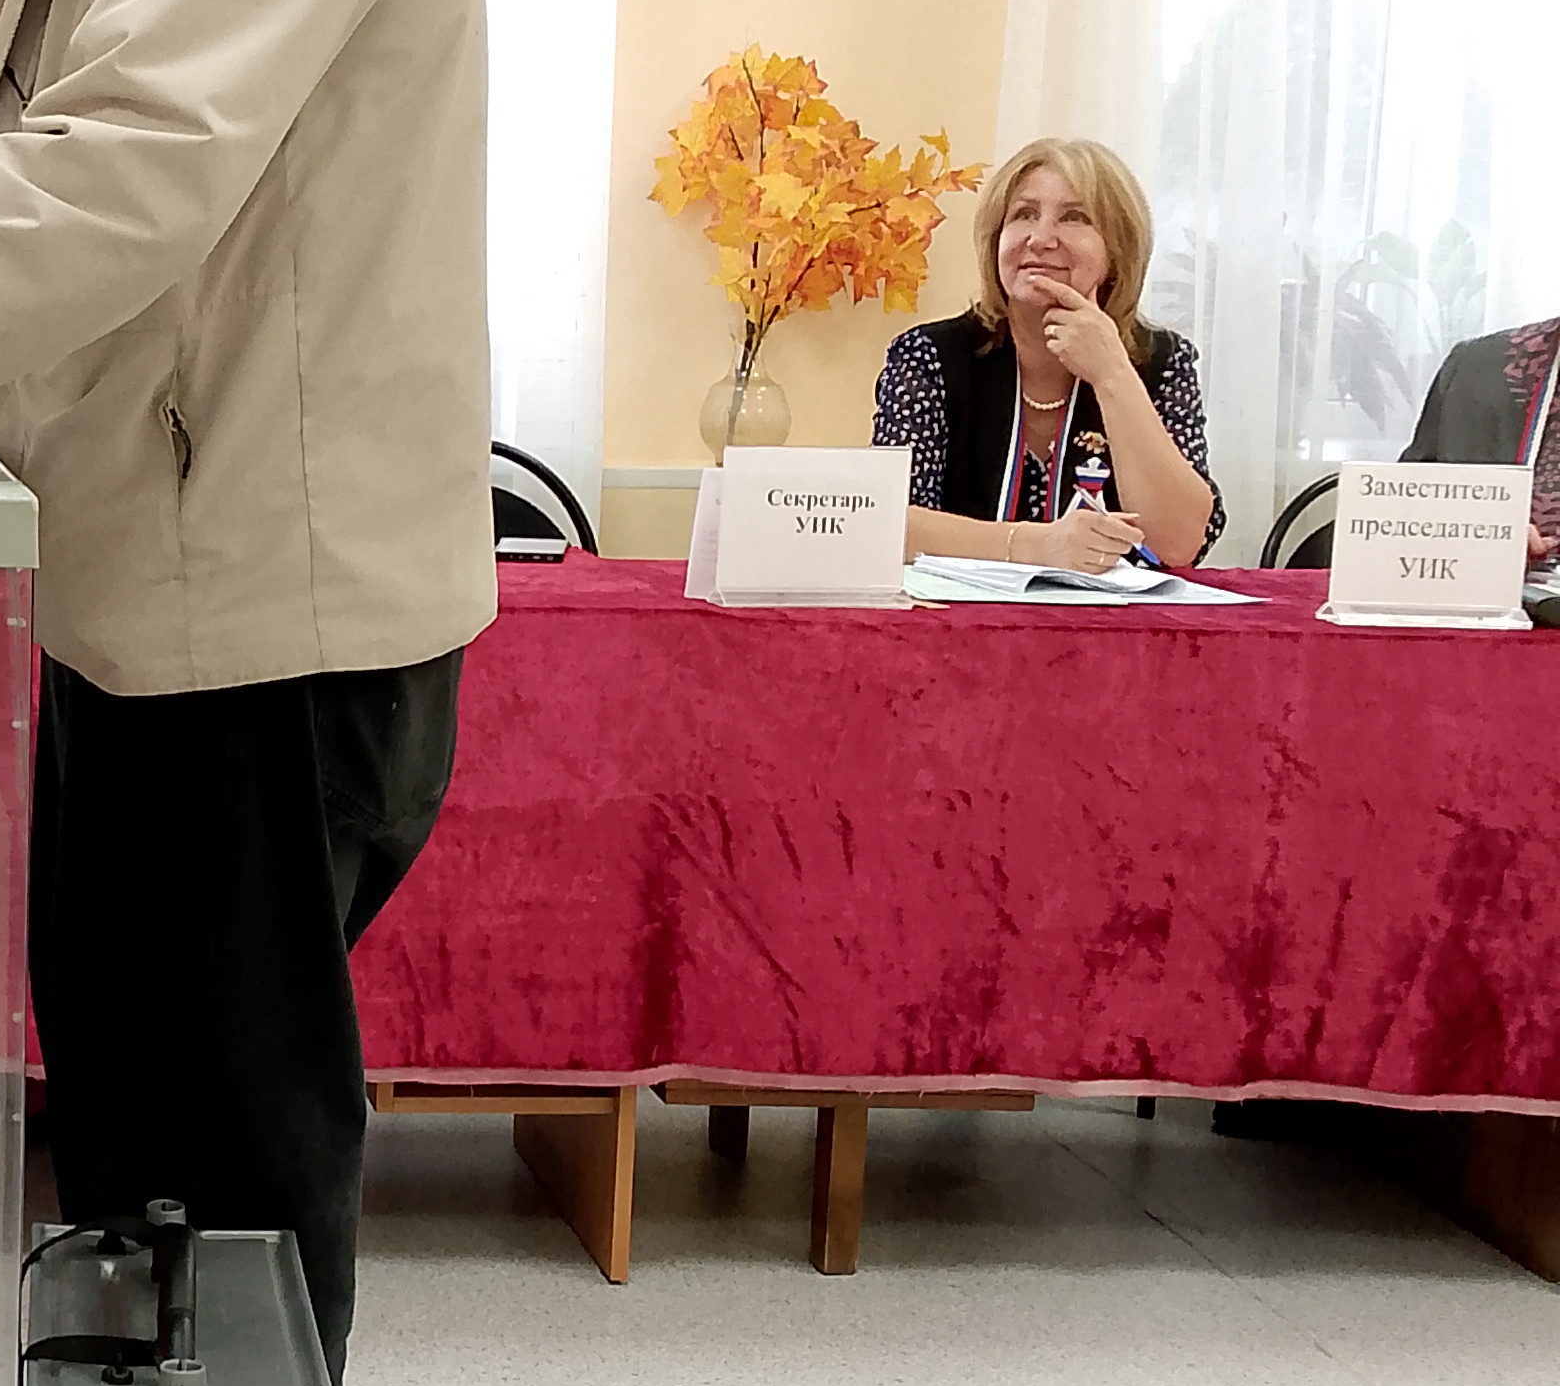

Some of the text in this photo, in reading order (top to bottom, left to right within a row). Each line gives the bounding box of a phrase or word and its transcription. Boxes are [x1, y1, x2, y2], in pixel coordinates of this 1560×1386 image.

[1358, 473, 1512, 501] Заместитель
[767, 489, 875, 512] Секретарь
[795, 516, 846, 535] УИК
[1350, 518, 1513, 540] председателя
[1398, 556, 1459, 581] УИК
